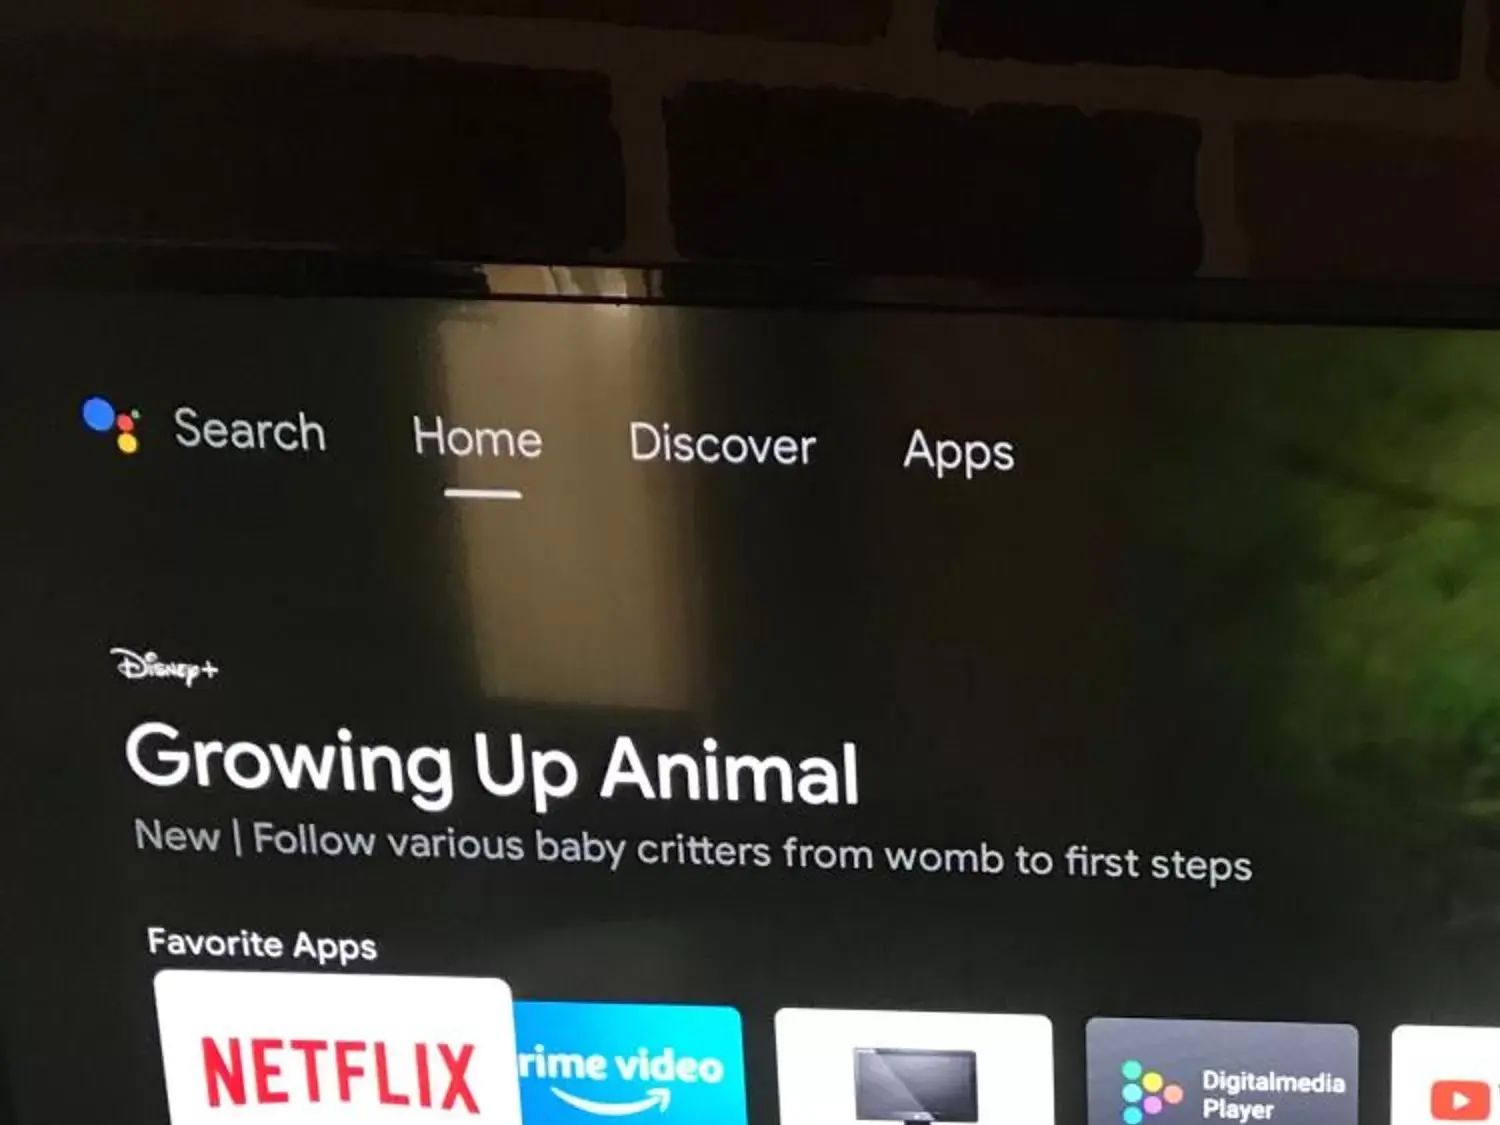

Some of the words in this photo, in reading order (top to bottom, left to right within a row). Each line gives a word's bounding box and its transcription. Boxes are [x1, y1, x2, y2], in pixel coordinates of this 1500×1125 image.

[174, 407, 326, 451] Search
[414, 416, 542, 457] Home
[630, 421, 816, 464] Discover
[903, 429, 1015, 479] Apps
[126, 721, 452, 810] Growing
[475, 732, 578, 812] Up
[600, 736, 858, 805] Animal
[135, 819, 220, 852] New
[254, 821, 375, 858] Follow
[388, 827, 524, 861] various
[537, 831, 626, 870] baby
[637, 834, 771, 867] critters
[783, 837, 873, 869] from
[885, 843, 1004, 876] womb
[1016, 846, 1053, 875] to
[1066, 846, 1139, 879] first
[1152, 850, 1252, 888] steps
[147, 927, 283, 958] Favorite
[293, 932, 377, 965] Apps
[201, 1036, 481, 1114] NETFLIX
[517, 1044, 607, 1080] rime
[614, 1047, 724, 1083] video
[1203, 1070, 1345, 1095] Digitalmedia
[1204, 1099, 1274, 1123] Player
